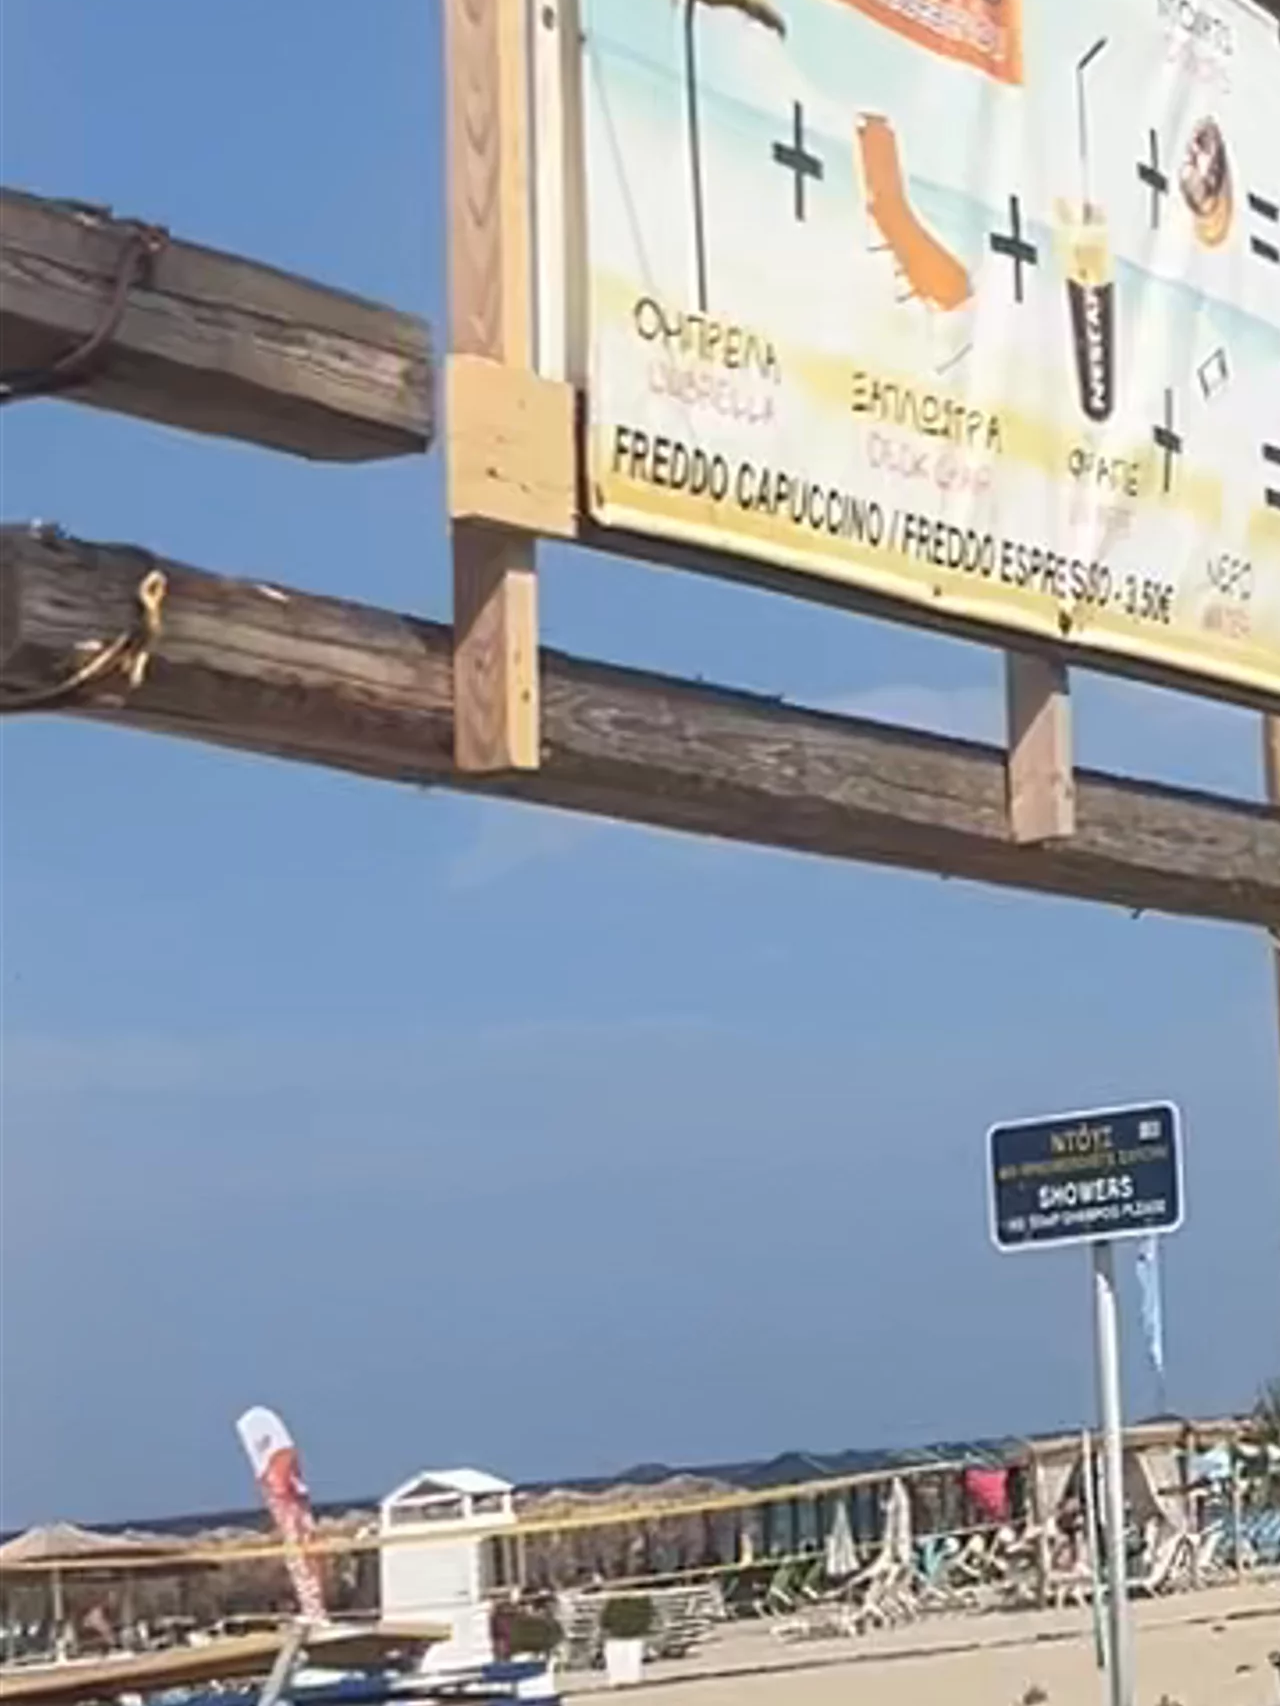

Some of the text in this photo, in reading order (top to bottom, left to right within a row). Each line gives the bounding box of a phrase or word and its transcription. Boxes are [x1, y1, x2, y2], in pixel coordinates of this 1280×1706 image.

[612, 424, 729, 501] FREDDO
[736, 462, 884, 548] CAPUCCINO
[902, 513, 995, 578] FREDDO
[1000, 540, 1112, 607] ESPRESSO
[1038, 1174, 1134, 1209] SHOWERS
